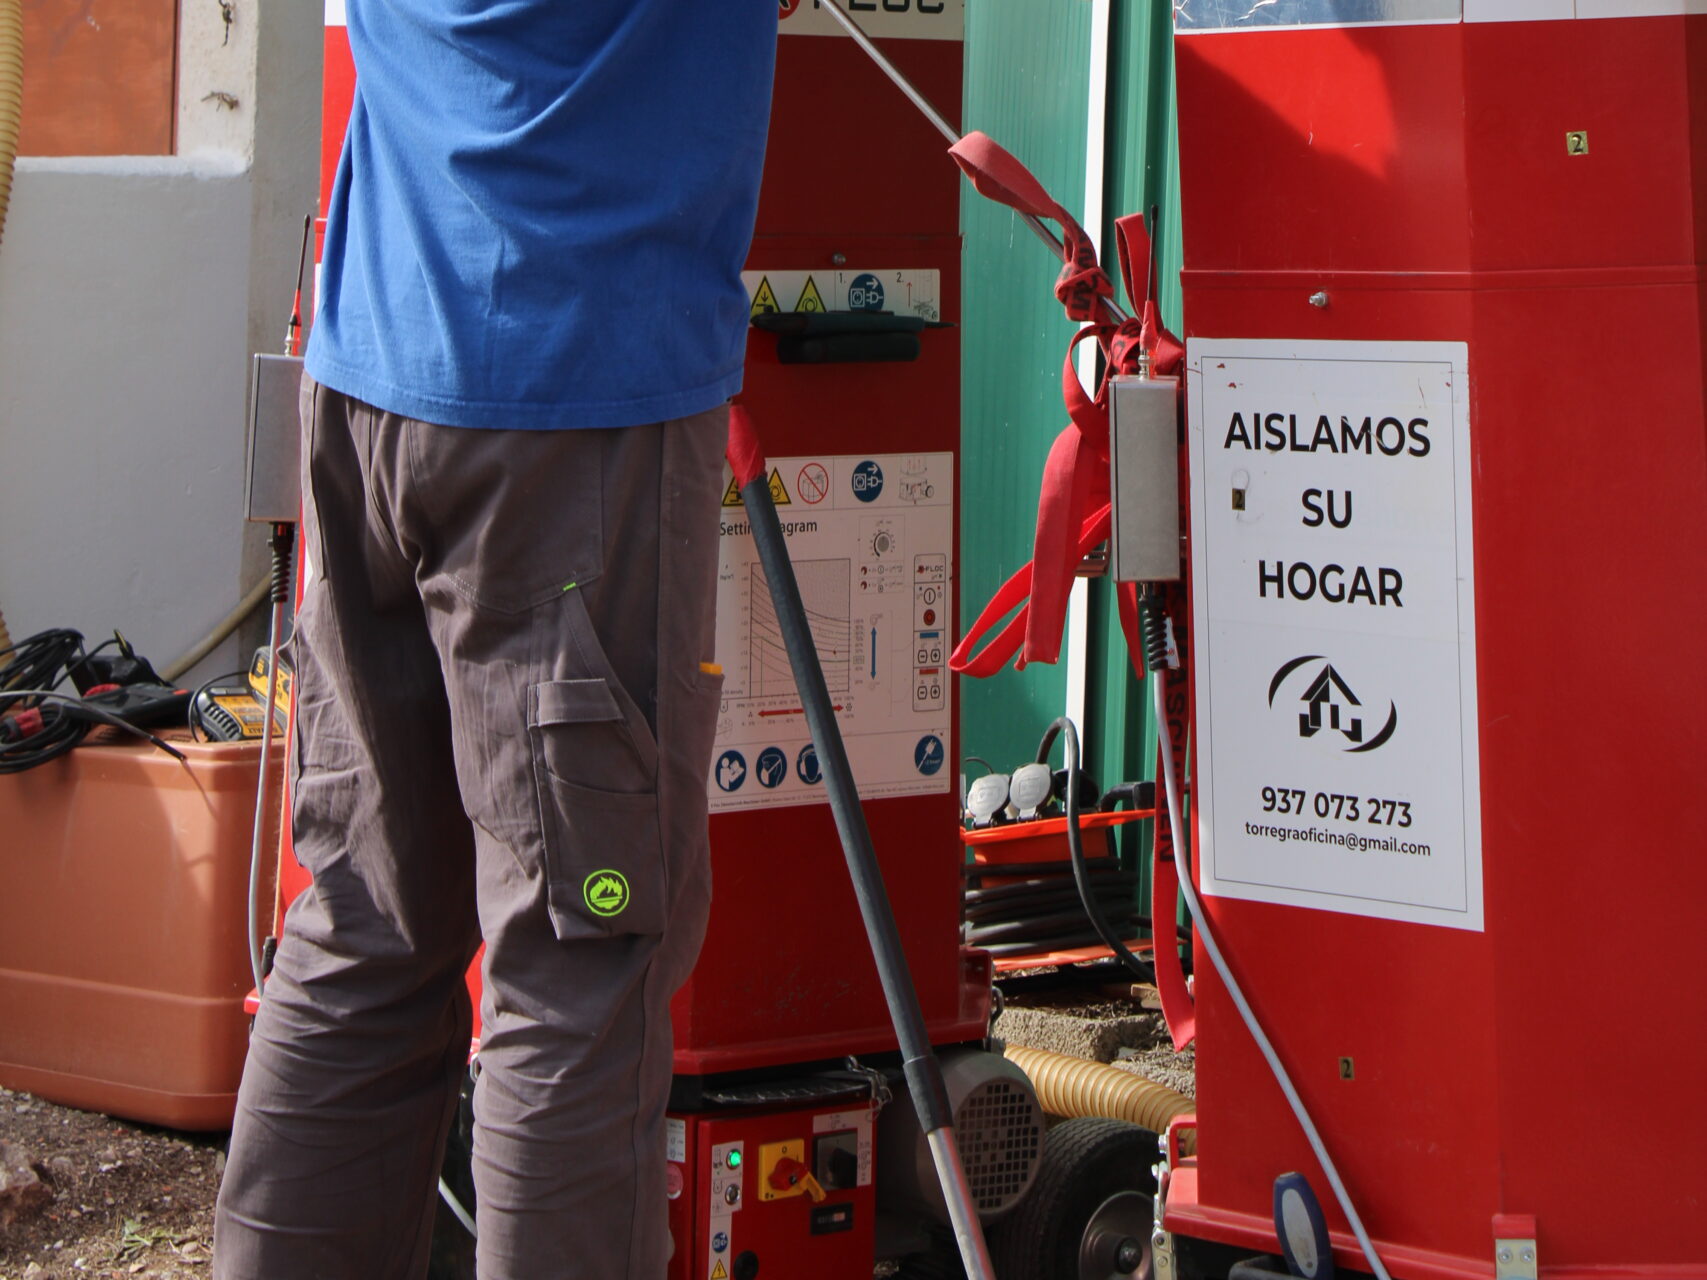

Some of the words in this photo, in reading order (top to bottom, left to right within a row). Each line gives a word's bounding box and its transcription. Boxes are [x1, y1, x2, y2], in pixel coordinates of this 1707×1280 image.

[1572, 134, 1583, 152] 2
[1224, 412, 1431, 457] AISLAMOS
[1235, 489, 1244, 508] 2
[1301, 488, 1353, 528] SU
[719, 522, 750, 536] Setti
[779, 521, 818, 537] agram
[1258, 560, 1403, 607] HOGAR
[1261, 786, 1306, 815] 937
[1314, 792, 1360, 821] 073
[1367, 798, 1412, 828] 273
[1245, 822, 1431, 856] torregraoficina@gmail.com
[1343, 1059, 1351, 1078] 2
